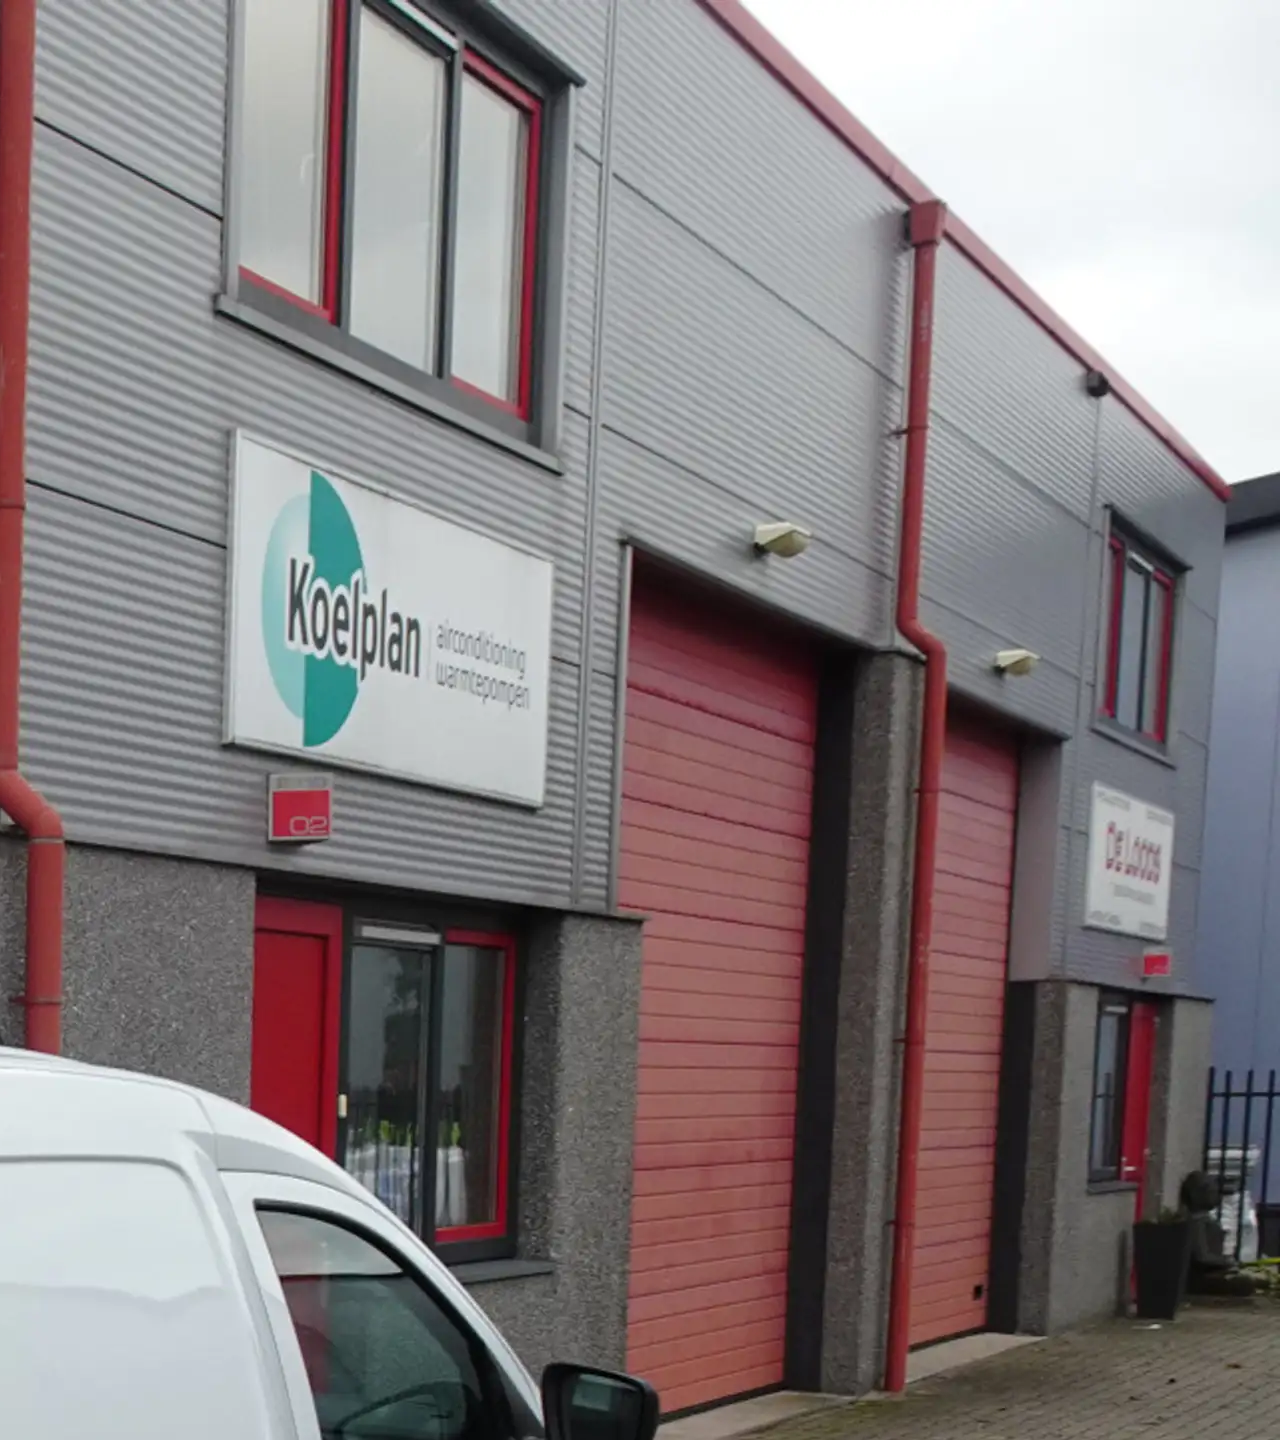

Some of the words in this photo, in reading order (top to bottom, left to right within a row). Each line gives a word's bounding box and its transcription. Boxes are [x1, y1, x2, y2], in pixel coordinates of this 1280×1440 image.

[288, 558, 421, 682] Koelplan
[437, 619, 526, 680] airconditioning
[436, 661, 530, 712] warmtepompen
[290, 815, 328, 835] 02
